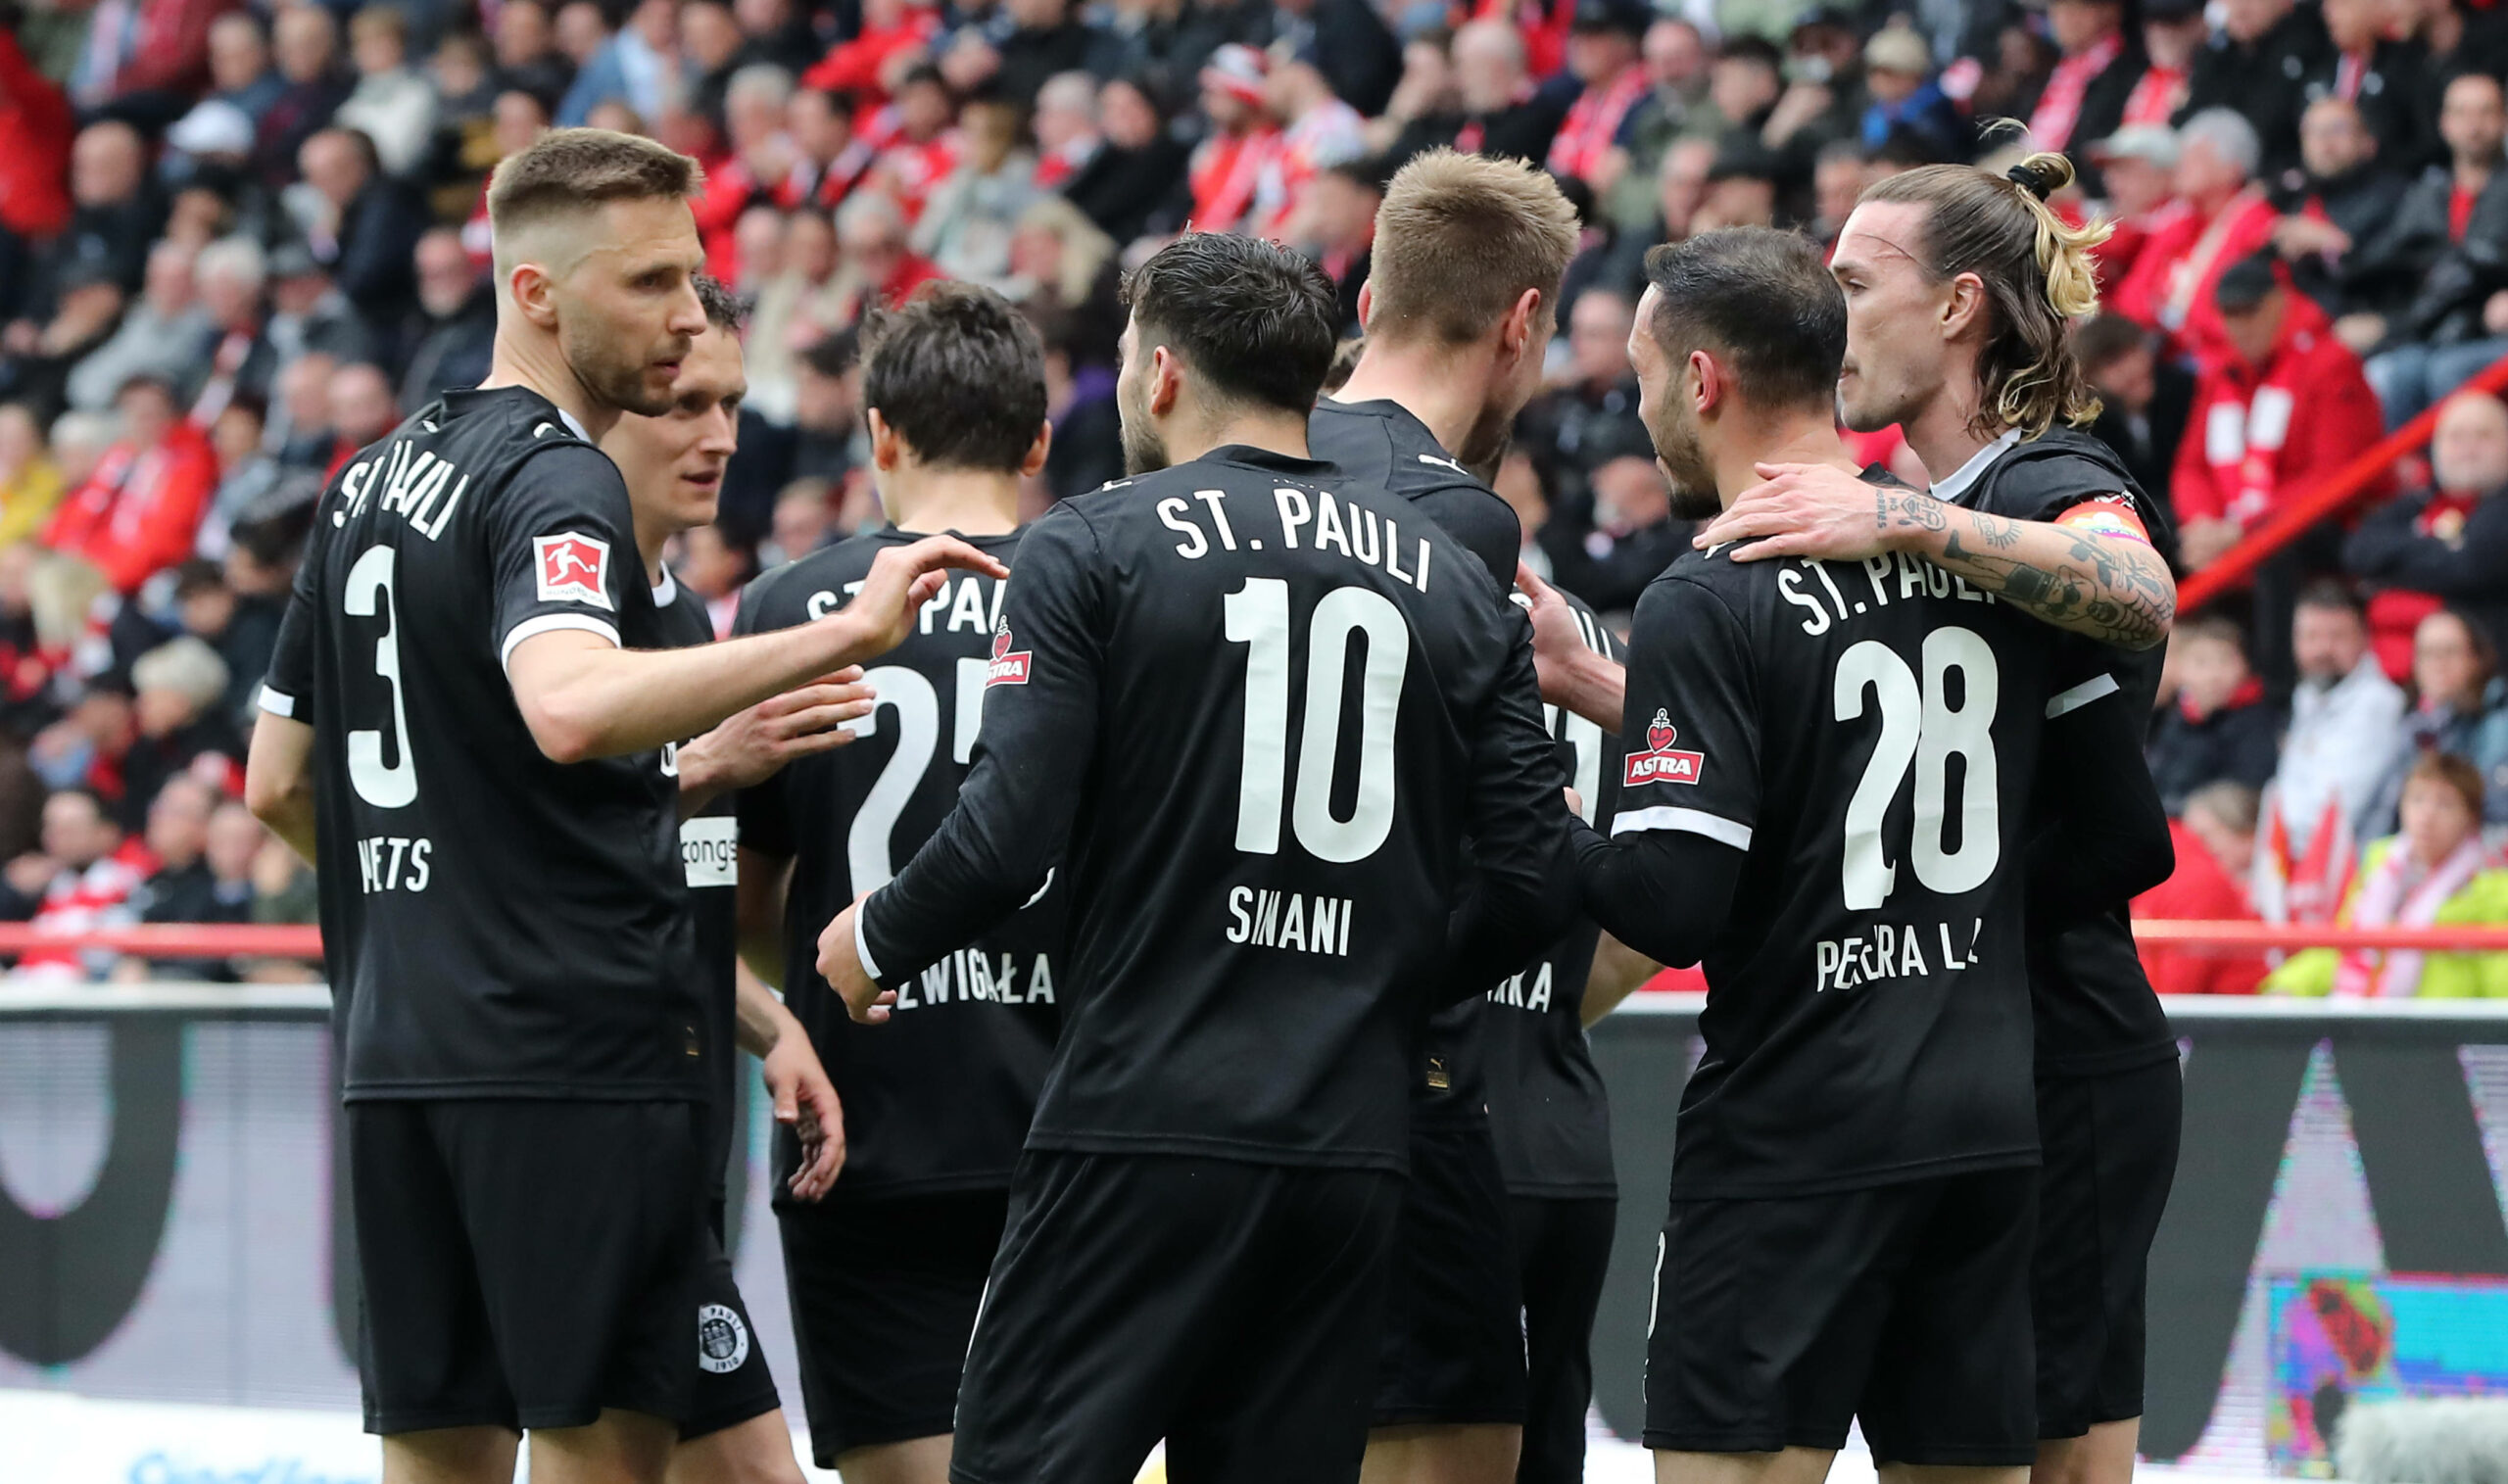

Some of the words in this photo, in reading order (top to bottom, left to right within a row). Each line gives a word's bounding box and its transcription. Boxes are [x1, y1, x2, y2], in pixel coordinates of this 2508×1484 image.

[1156, 489, 1264, 559] ST.
[1274, 488, 1431, 593] PAULI
[344, 545, 418, 808] 3
[1224, 577, 1409, 863] 10
[1630, 756, 1692, 778] ASTRA
[1834, 626, 2000, 911] 28
